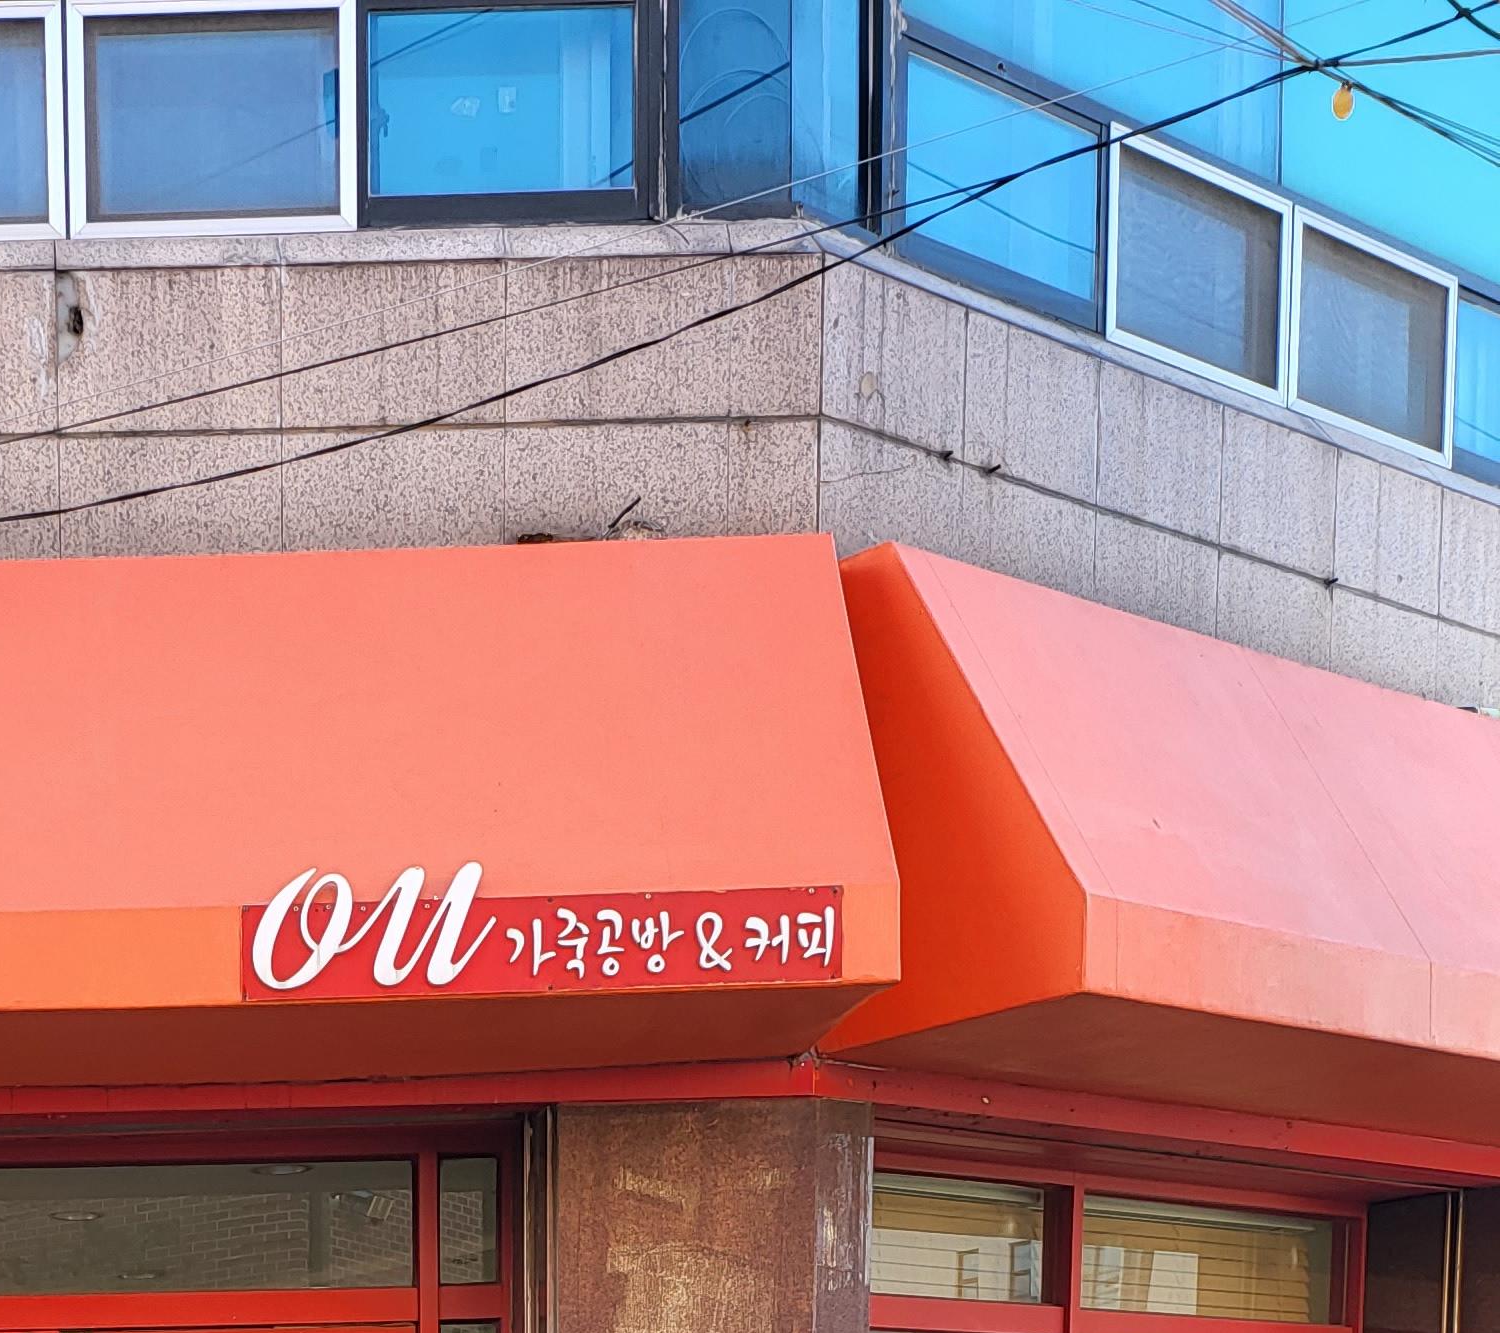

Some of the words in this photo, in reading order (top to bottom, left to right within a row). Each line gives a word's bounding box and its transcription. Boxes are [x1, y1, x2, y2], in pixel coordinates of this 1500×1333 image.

[506, 906, 685, 979] 가죽공방
[696, 911, 733, 972] &
[744, 905, 835, 967] 커피
